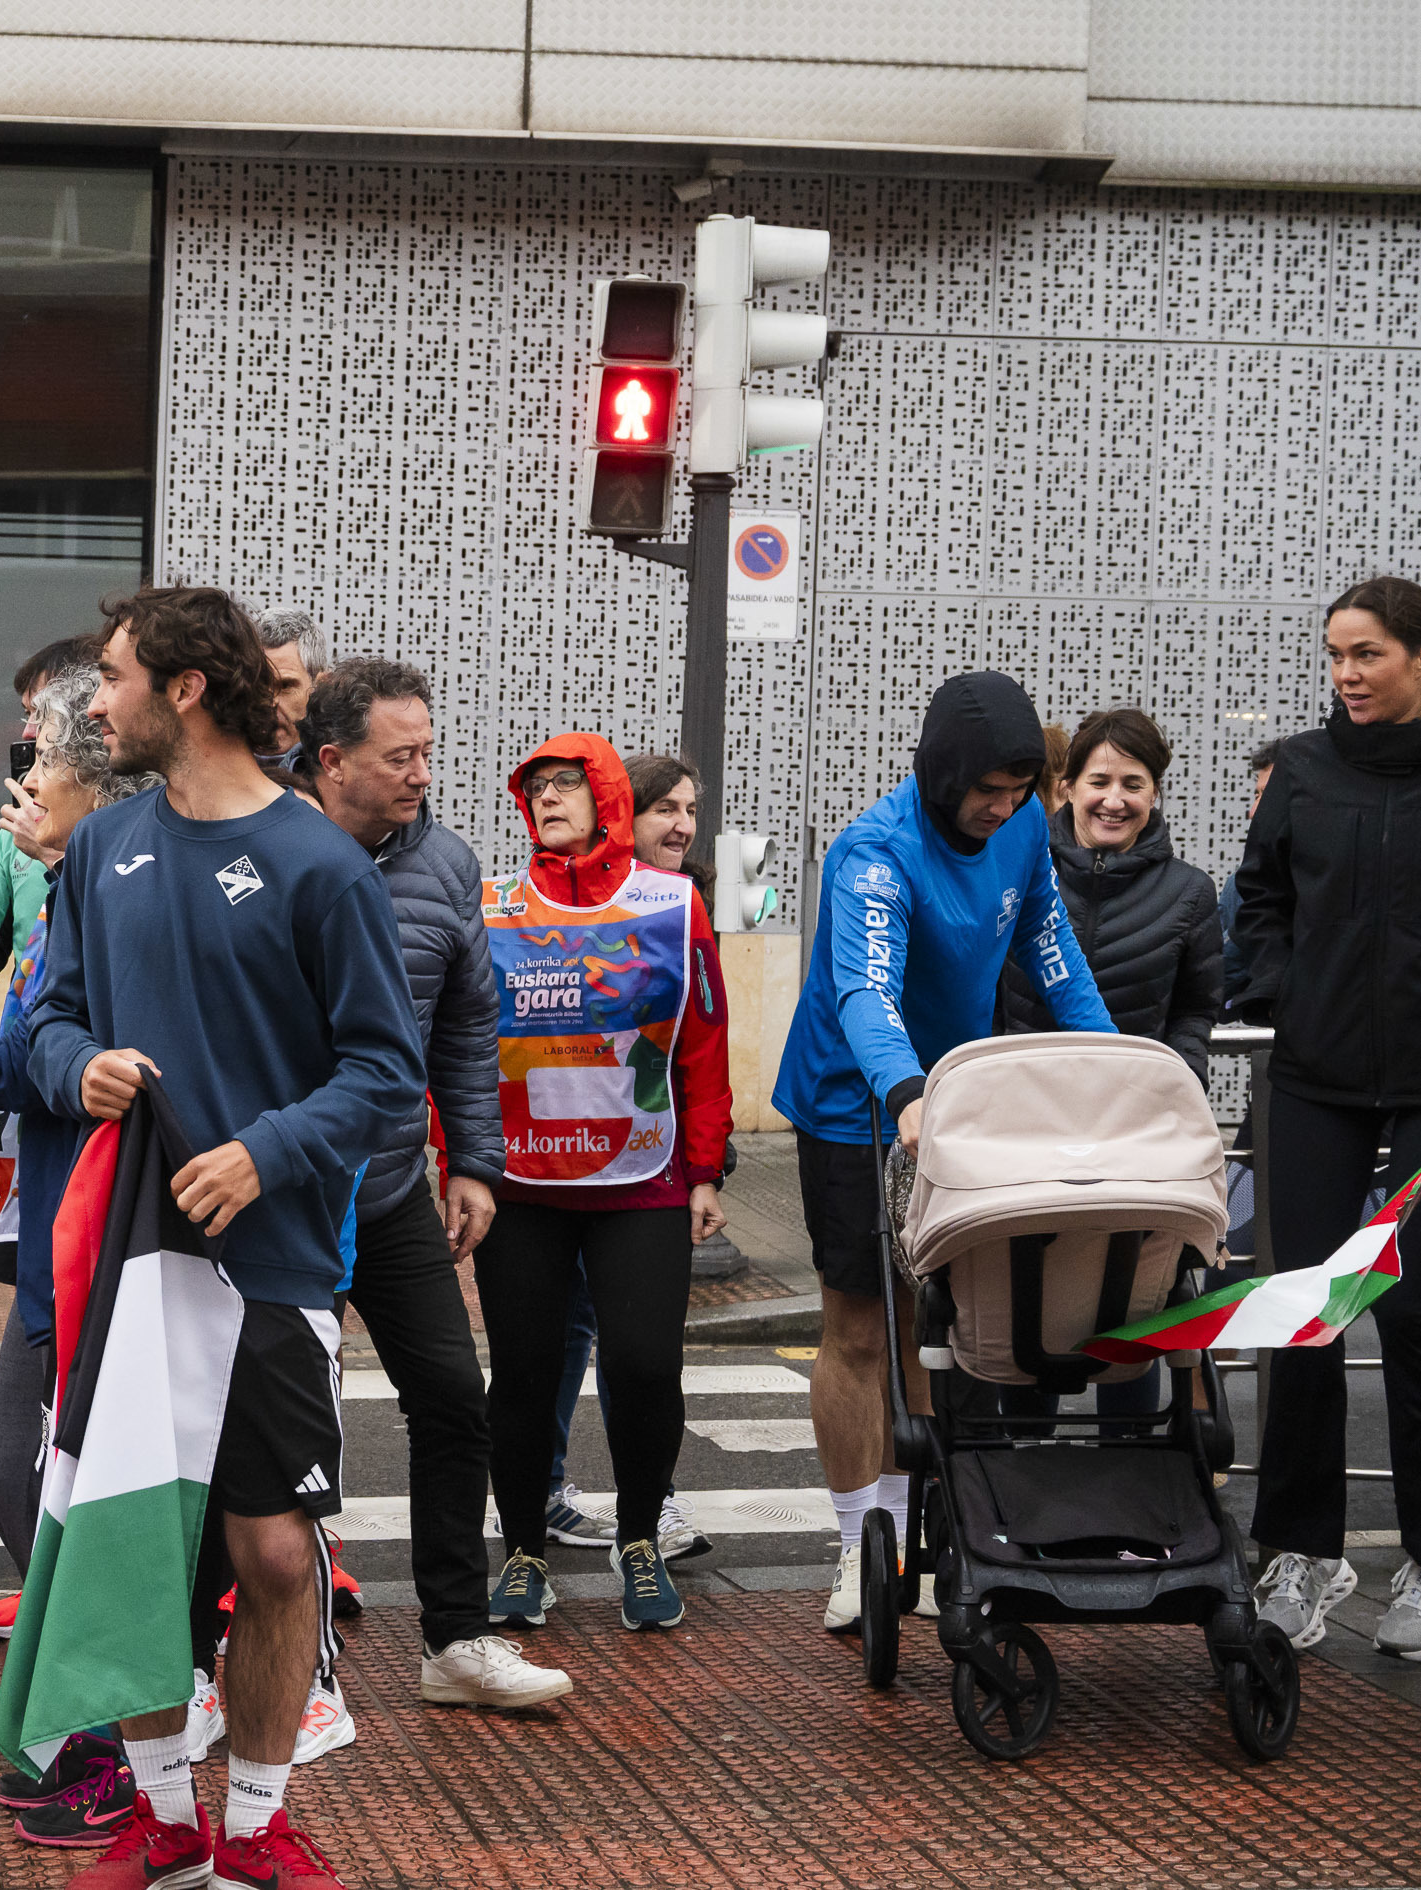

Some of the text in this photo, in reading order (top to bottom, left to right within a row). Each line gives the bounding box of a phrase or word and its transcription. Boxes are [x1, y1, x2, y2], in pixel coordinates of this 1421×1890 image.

[774, 595, 795, 603] VADO
[643, 893, 680, 903] eitb
[515, 956, 562, 969] 24.korrika
[505, 968, 581, 989] Euskara
[515, 987, 581, 1017] gara
[543, 1046, 592, 1055] LABORAL
[628, 1120, 664, 1151] aek
[230, 1779, 273, 1798] adidas
